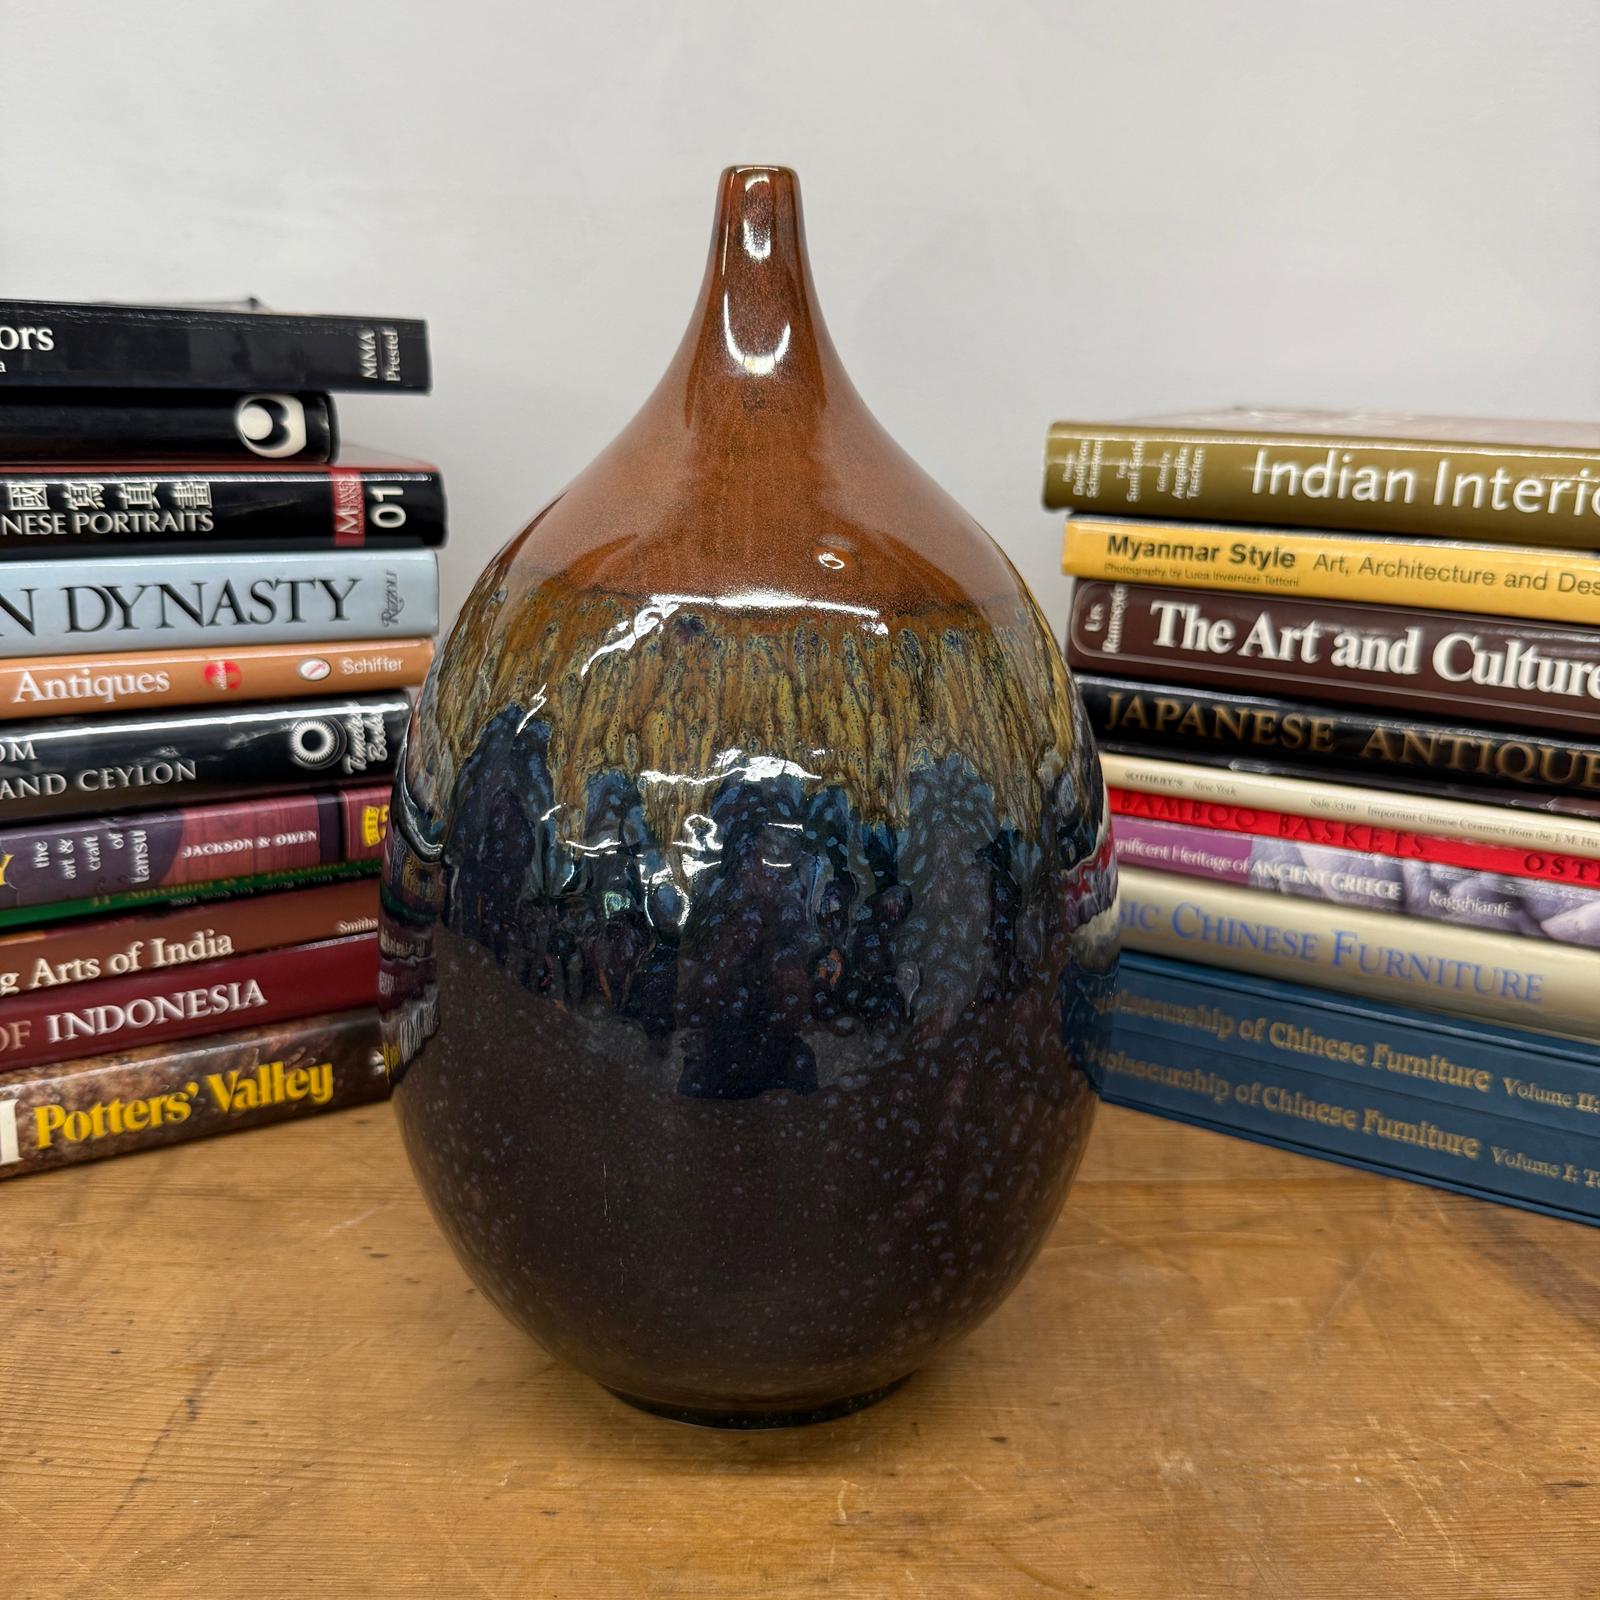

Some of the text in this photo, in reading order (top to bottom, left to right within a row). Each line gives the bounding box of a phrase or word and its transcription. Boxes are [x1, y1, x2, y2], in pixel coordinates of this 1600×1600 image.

[0, 326, 55, 351] ors
[357, 328, 378, 379] MMA
[1251, 447, 1415, 503] Indian
[0, 510, 215, 536] NESE PORTRAITS
[368, 485, 407, 529] 01
[1104, 562, 1166, 579] Photography
[1169, 567, 1182, 580] by
[1107, 535, 1600, 597] Myanmar Style Art, Architecture and Des
[60, 576, 363, 634] DYNASTY
[1150, 600, 1236, 654] The
[1237, 611, 1321, 665] Art
[1331, 626, 1424, 675] and
[12, 667, 171, 704] Antiques
[341, 657, 404, 675] Schiffer
[1105, 692, 1600, 789] JAPANESE ANTIQUE
[0, 759, 197, 800] AND CEYLON
[1119, 788, 1600, 881] BAMBOO BASKETS OST
[1192, 779, 1214, 793] New
[1216, 783, 1238, 797] York
[1367, 805, 1418, 823] Important
[1419, 811, 1458, 828] Chinese
[1459, 818, 1507, 835] Ceramics
[1508, 826, 1533, 839] from
[1535, 829, 1552, 841] the
[32, 841, 51, 869] the
[57, 838, 77, 880] art &
[81, 835, 102, 872] craft
[106, 832, 125, 850] of
[129, 829, 150, 884] tansu
[182, 829, 318, 860] JACKSON & OWEN
[1232, 857, 1249, 874] of
[1252, 859, 1329, 890] ANCIENT
[1332, 869, 1401, 900] GREECE
[30, 957, 101, 989] Arts
[108, 940, 145, 976] of
[149, 929, 235, 966] India
[1172, 900, 1319, 962] CHINESE
[1331, 929, 1544, 1004] FURNITURE
[46, 978, 269, 1045] INDONESIA
[207, 1061, 334, 1116] Valley
[1239, 1016, 1268, 1042] of
[1269, 1021, 1366, 1065] Chinese
[1371, 1043, 1493, 1093] Furniture
[1503, 1076, 1573, 1108] Volume
[1235, 1081, 1263, 1104] of
[1262, 1084, 1358, 1131] Chinese
[1362, 1108, 1481, 1160] Furniture
[1490, 1145, 1561, 1178] Volume
